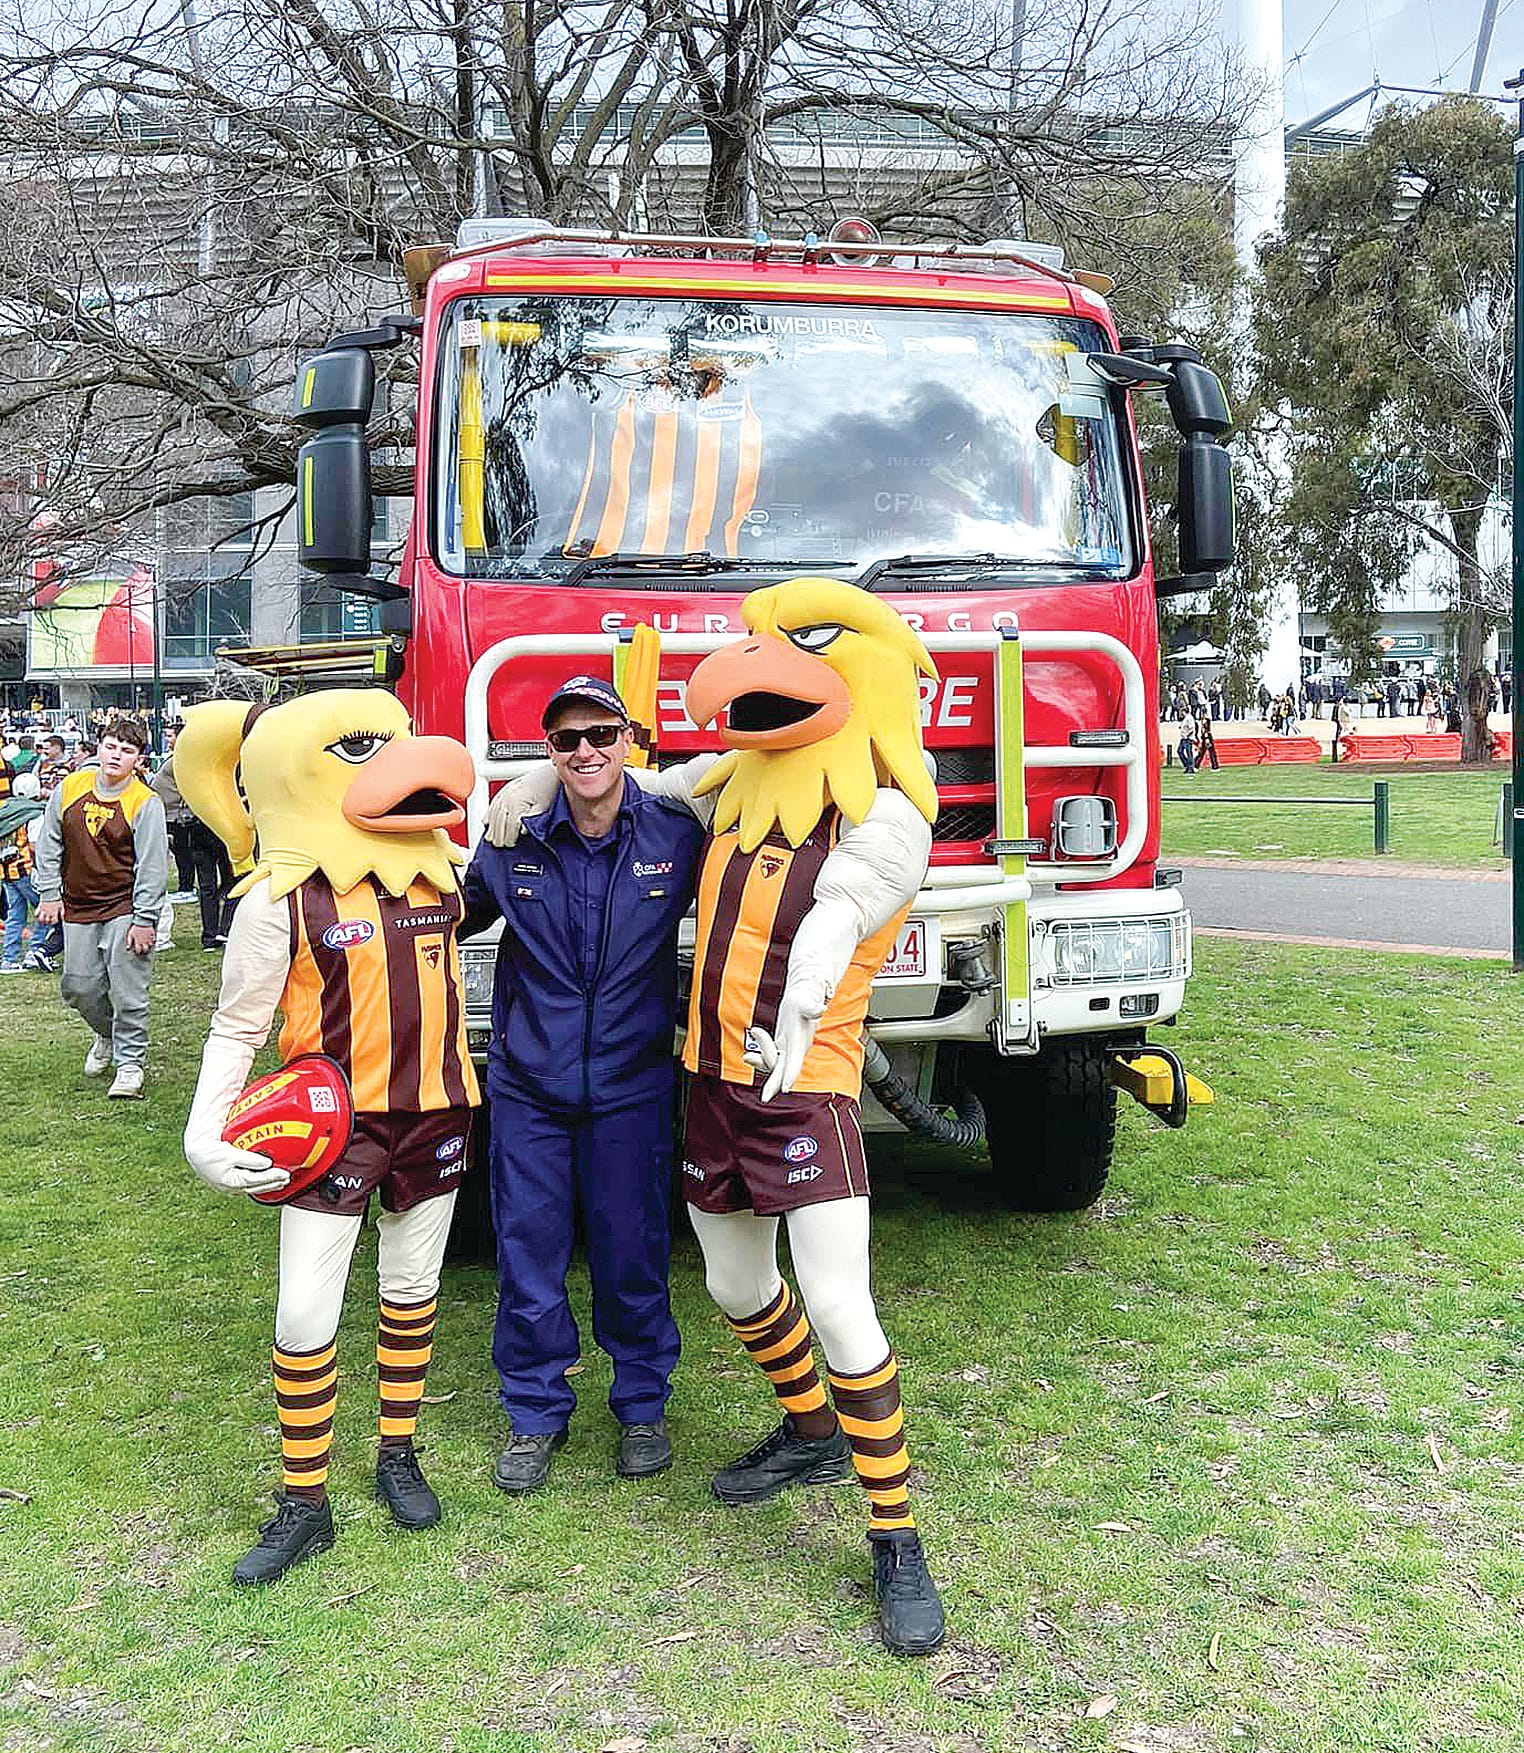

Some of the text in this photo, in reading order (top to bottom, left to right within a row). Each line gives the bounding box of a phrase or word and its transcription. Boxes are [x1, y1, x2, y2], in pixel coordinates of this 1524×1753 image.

[706, 313, 877, 337] KORUMBURRA
[874, 491, 926, 517] CFA
[918, 677, 979, 727] RE
[329, 922, 373, 947] AFL
[896, 964, 918, 973] STATE
[238, 1124, 284, 1149] PTAIN
[440, 1139, 462, 1158] AFL
[788, 1140, 815, 1158] AFL
